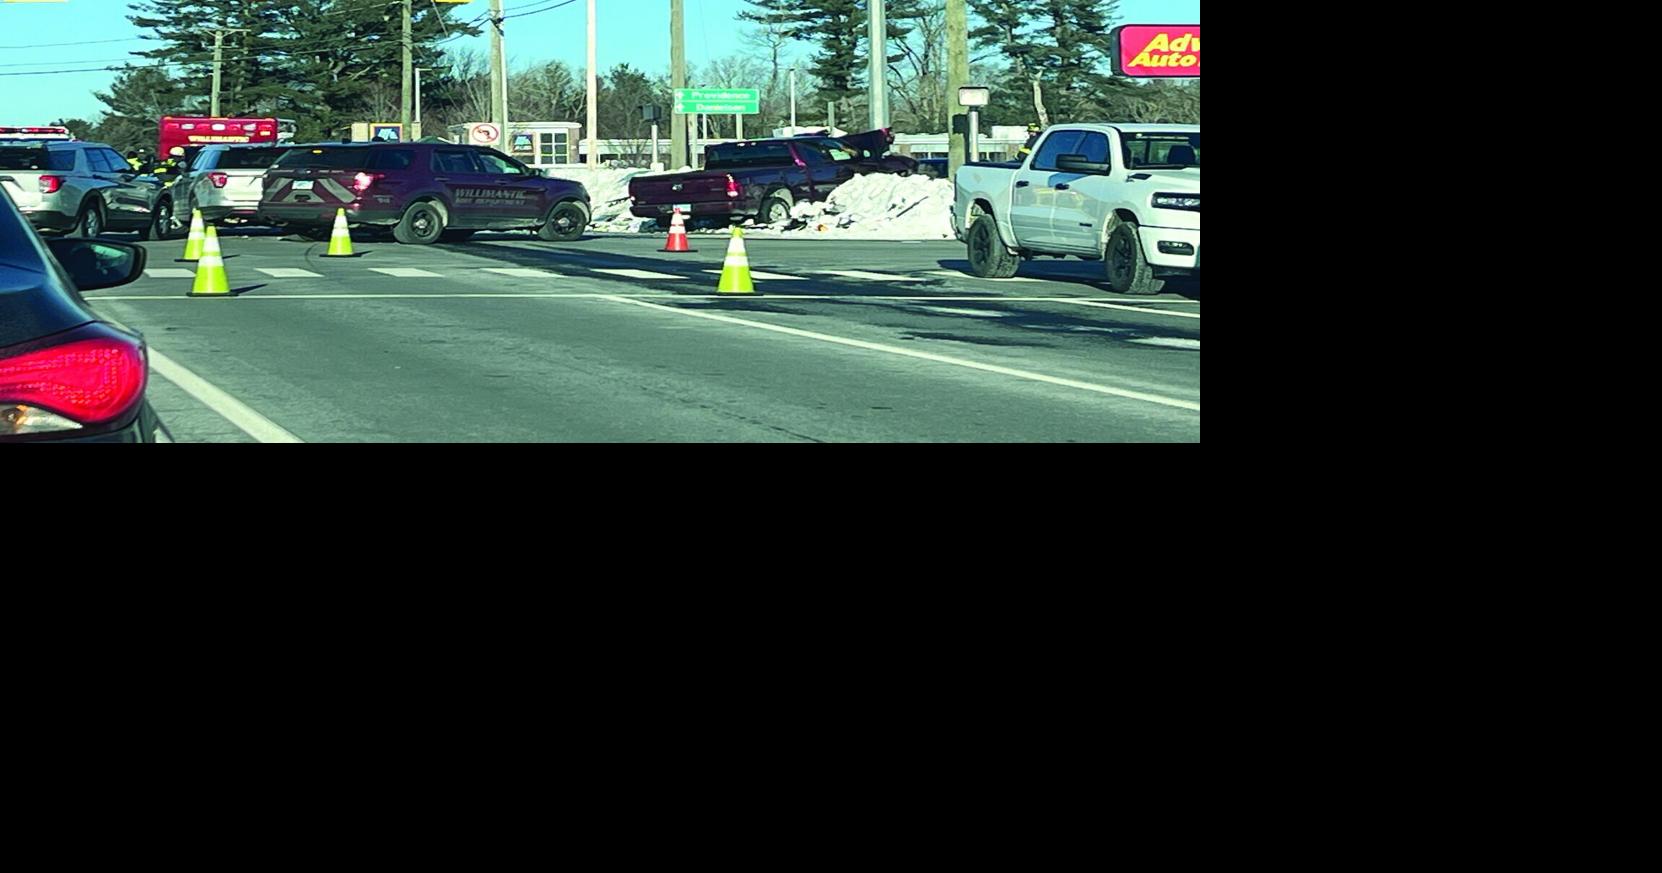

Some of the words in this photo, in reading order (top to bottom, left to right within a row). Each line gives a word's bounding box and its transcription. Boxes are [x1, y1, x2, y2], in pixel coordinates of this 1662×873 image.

[1127, 52, 1197, 67] Auto
[691, 91, 750, 99] Providence
[188, 135, 250, 143] WILLIMANTIC
[456, 188, 527, 199] WILLIMANTIC
